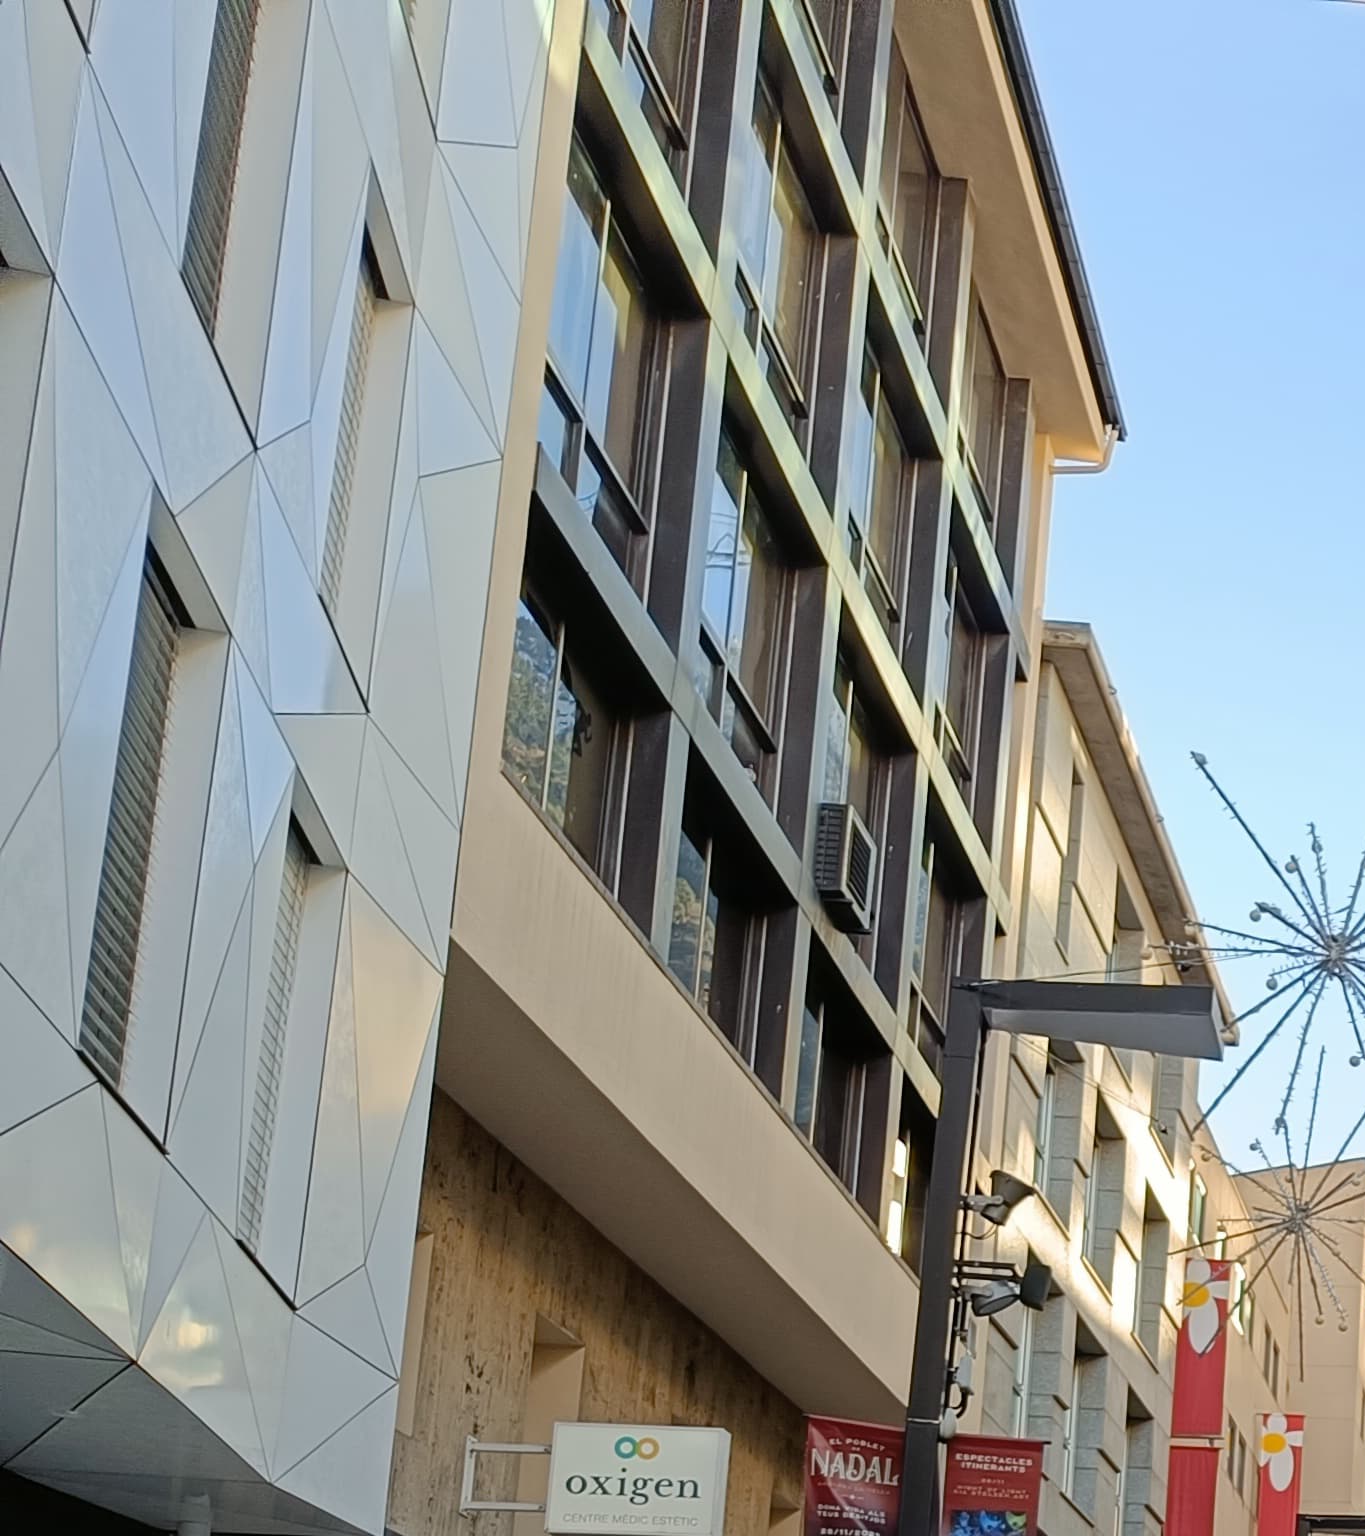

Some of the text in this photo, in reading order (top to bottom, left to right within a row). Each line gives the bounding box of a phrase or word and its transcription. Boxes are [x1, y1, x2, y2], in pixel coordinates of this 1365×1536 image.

[810, 1447, 900, 1486] NADAL
[955, 1453, 1033, 1467] ESPECTACLES
[961, 1462, 1027, 1474] ITINERANTS
[565, 1467, 701, 1506] oxigen
[563, 1513, 609, 1524] CENTRE
